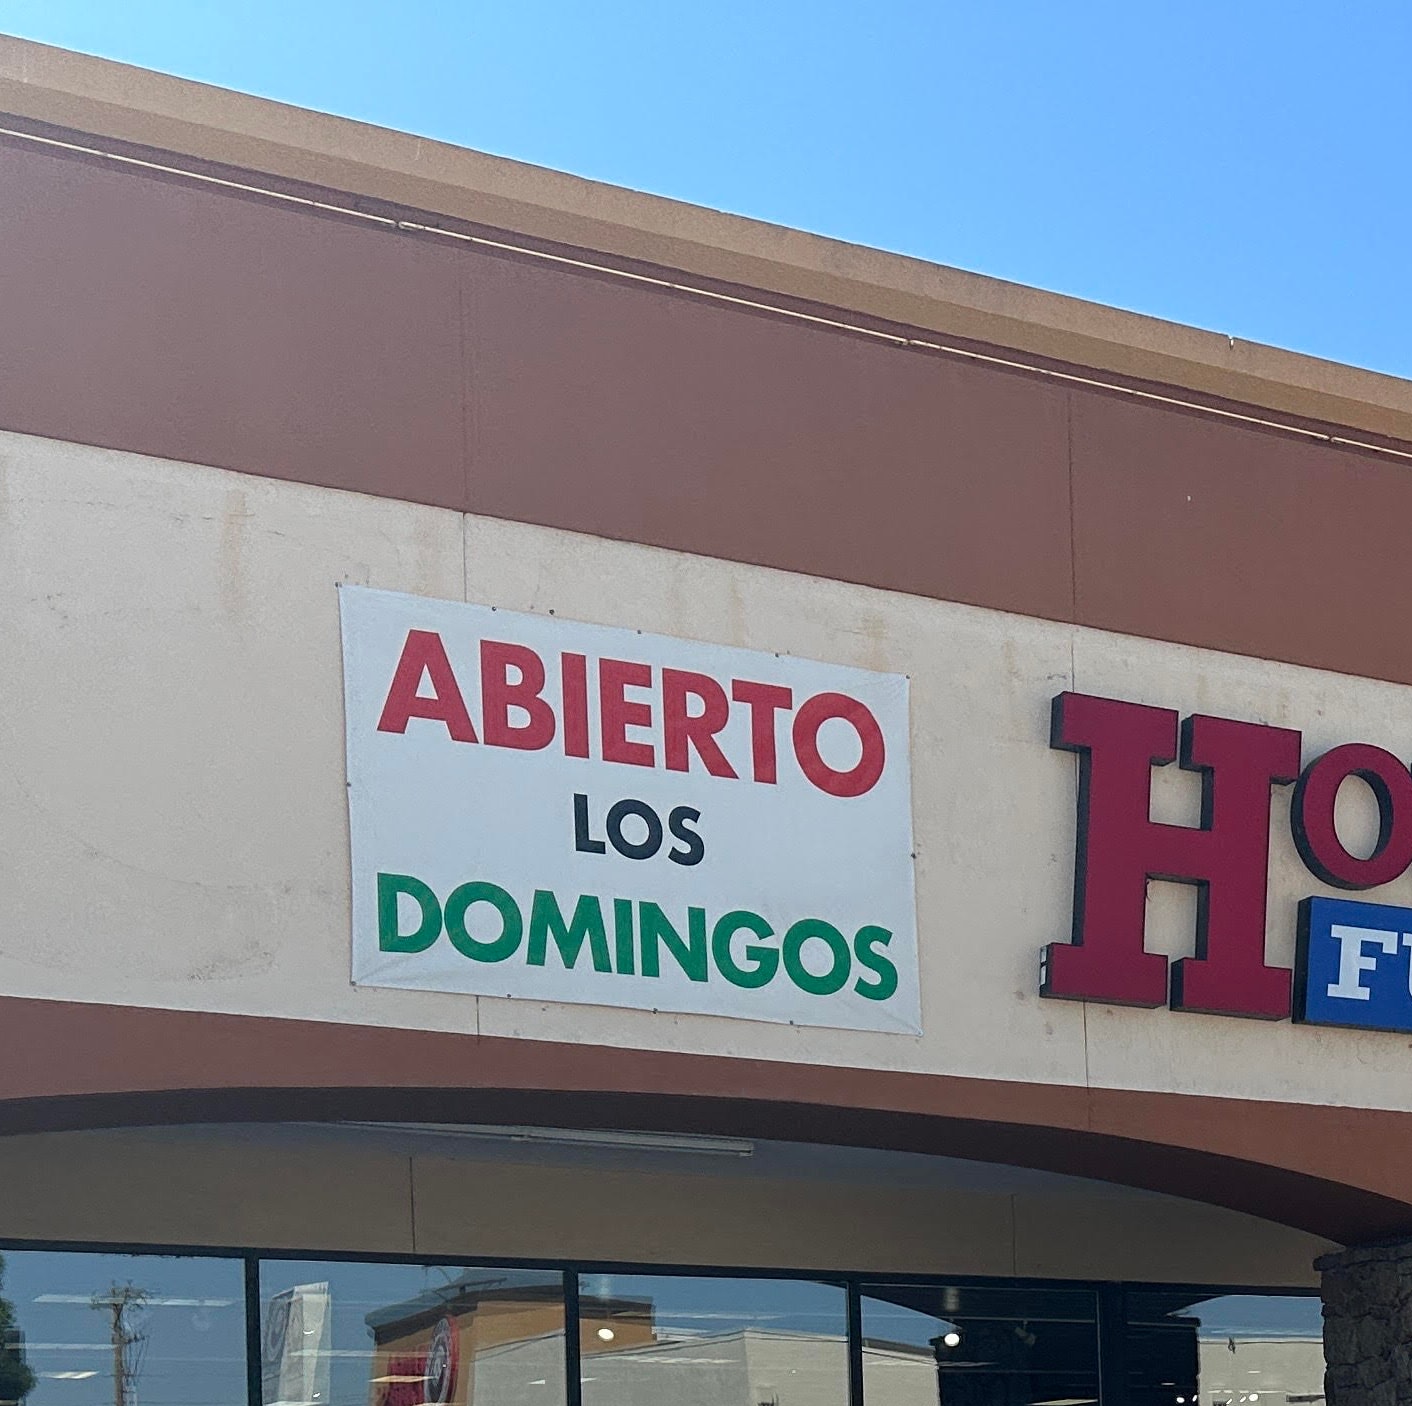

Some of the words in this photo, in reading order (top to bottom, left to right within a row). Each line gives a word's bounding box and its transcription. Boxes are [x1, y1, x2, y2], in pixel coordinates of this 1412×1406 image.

[377, 629, 886, 798] ABIERTO
[573, 792, 706, 867] LOS
[376, 871, 899, 1001] DOMINGOS
